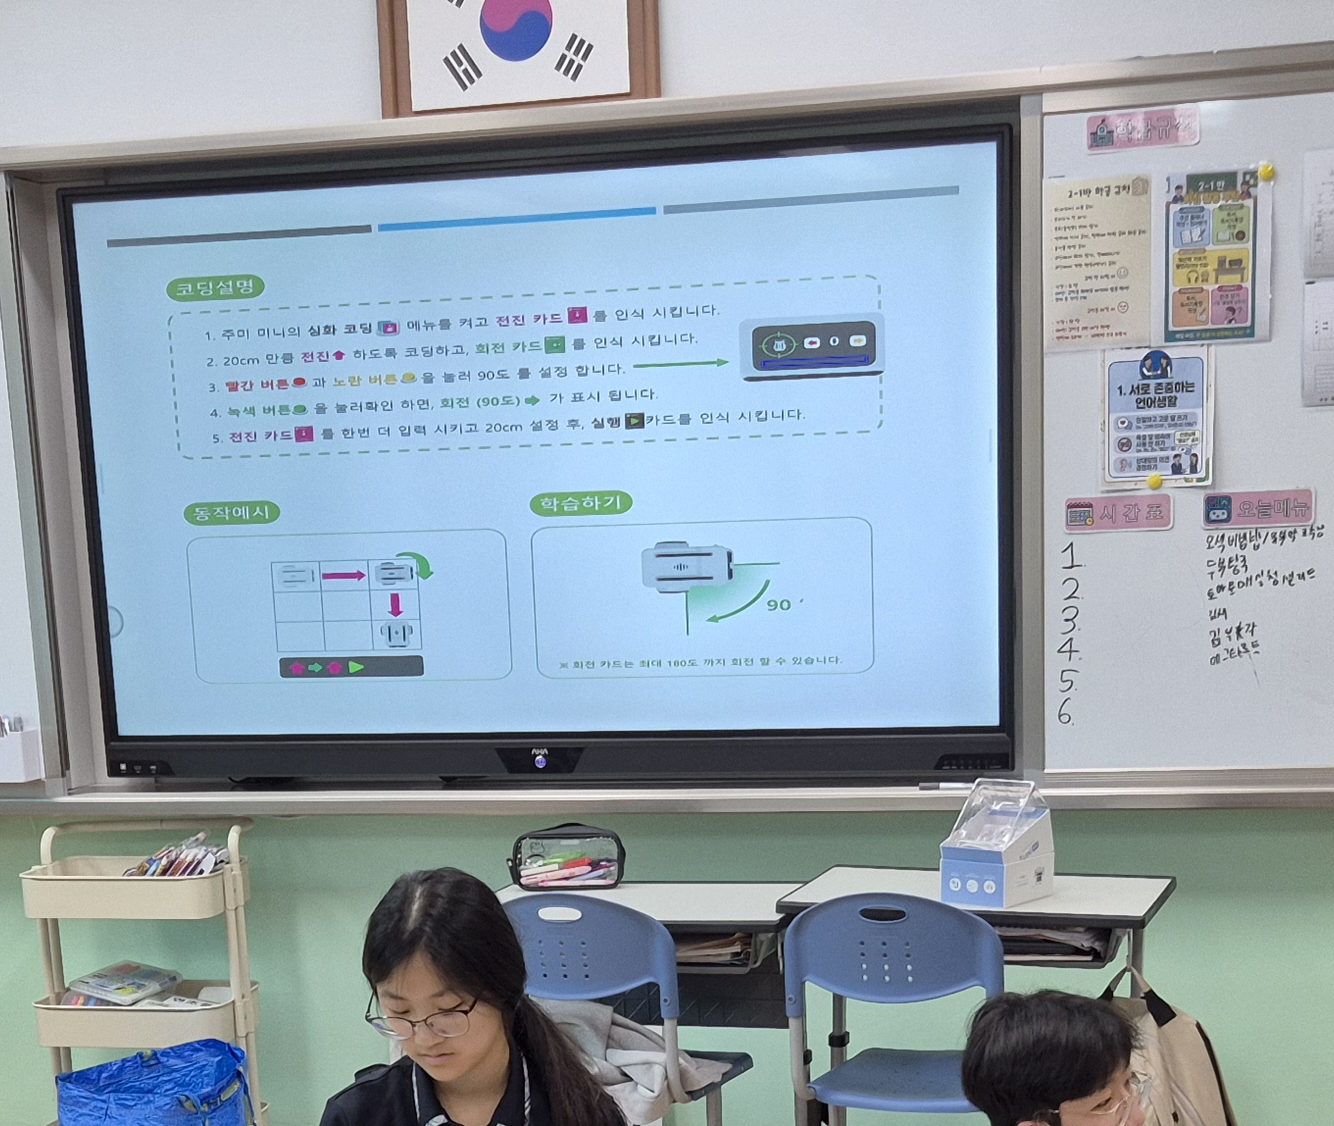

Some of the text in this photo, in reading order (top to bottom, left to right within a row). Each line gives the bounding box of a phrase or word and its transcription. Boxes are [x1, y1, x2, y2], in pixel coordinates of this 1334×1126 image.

[176, 279, 254, 296] 코딩설명
[205, 304, 720, 341] 1. 주미 미니의 심화 코딩 메뉴를 켜고 전진 카드 를 인식 시킵니다.
[206, 332, 698, 367] 2. 20cm 만큼 전진 하도록 코딩하고, 회전 카드 를 인식 시킵니다.
[208, 362, 626, 393] 3. 빨간 버튼 과 노란 버튼 을 눌러 90도 를 설정 합니다.
[1117, 381, 1195, 397] 1. 서로 존중하는
[210, 388, 659, 418] 4. 녹색 버튼 을 눌러확인 하면, 회전 (90도) 가 표시 됩니다.
[1135, 396, 1178, 409] 언어생활
[212, 408, 806, 445] 5. 전진 카드 를 한번 더 입력 시키고 20cm 설정 후, 실행 카드를 인식 시킵니다.
[193, 505, 269, 521] 동작예시
[540, 495, 622, 512] 학습하기
[1237, 497, 1310, 519] 오늘메뉴
[573, 660, 596, 670] 회전
[600, 659, 634, 670] 카드는
[639, 658, 662, 669] 최대
[667, 658, 698, 669] 180도
[703, 657, 727, 668] 까지
[731, 657, 755, 668] 회전
[775, 656, 786, 667] 수
[792, 655, 844, 667] 있습니다.
